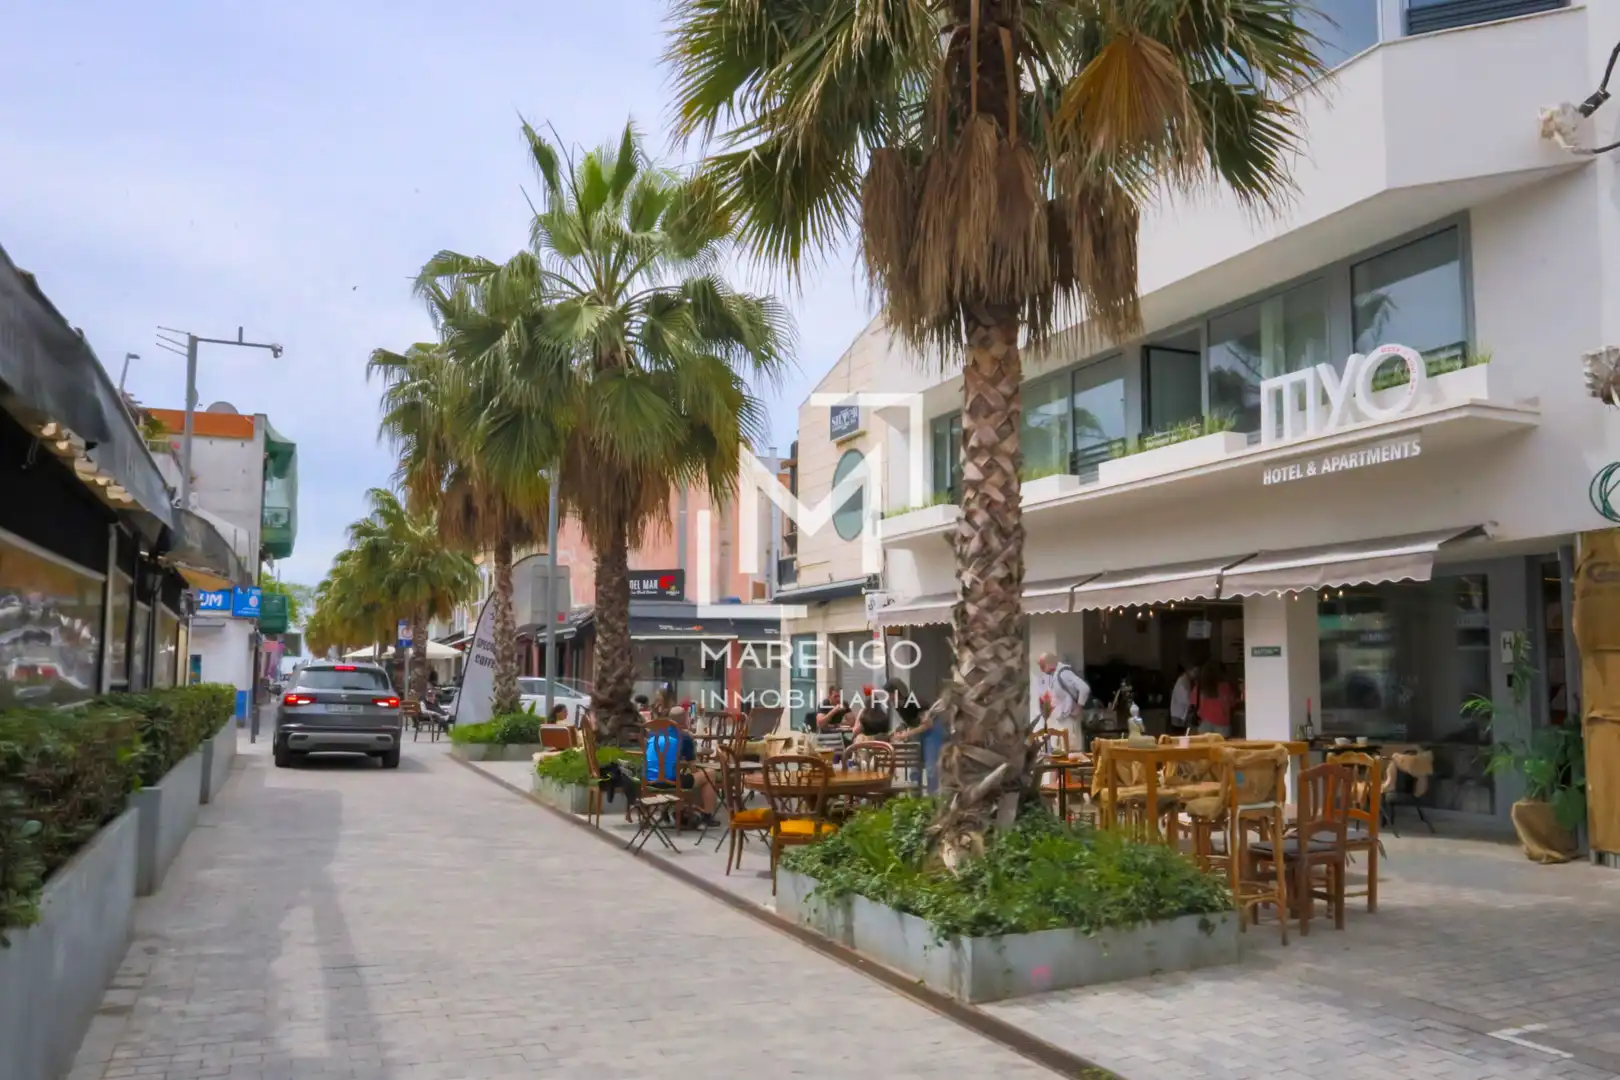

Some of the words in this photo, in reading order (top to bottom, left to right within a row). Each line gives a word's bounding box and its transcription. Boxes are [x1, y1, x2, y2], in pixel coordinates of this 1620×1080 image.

[1263, 464, 1303, 485] HOTEL
[1306, 461, 1317, 476] &
[1321, 439, 1421, 474] APARTMENTS
